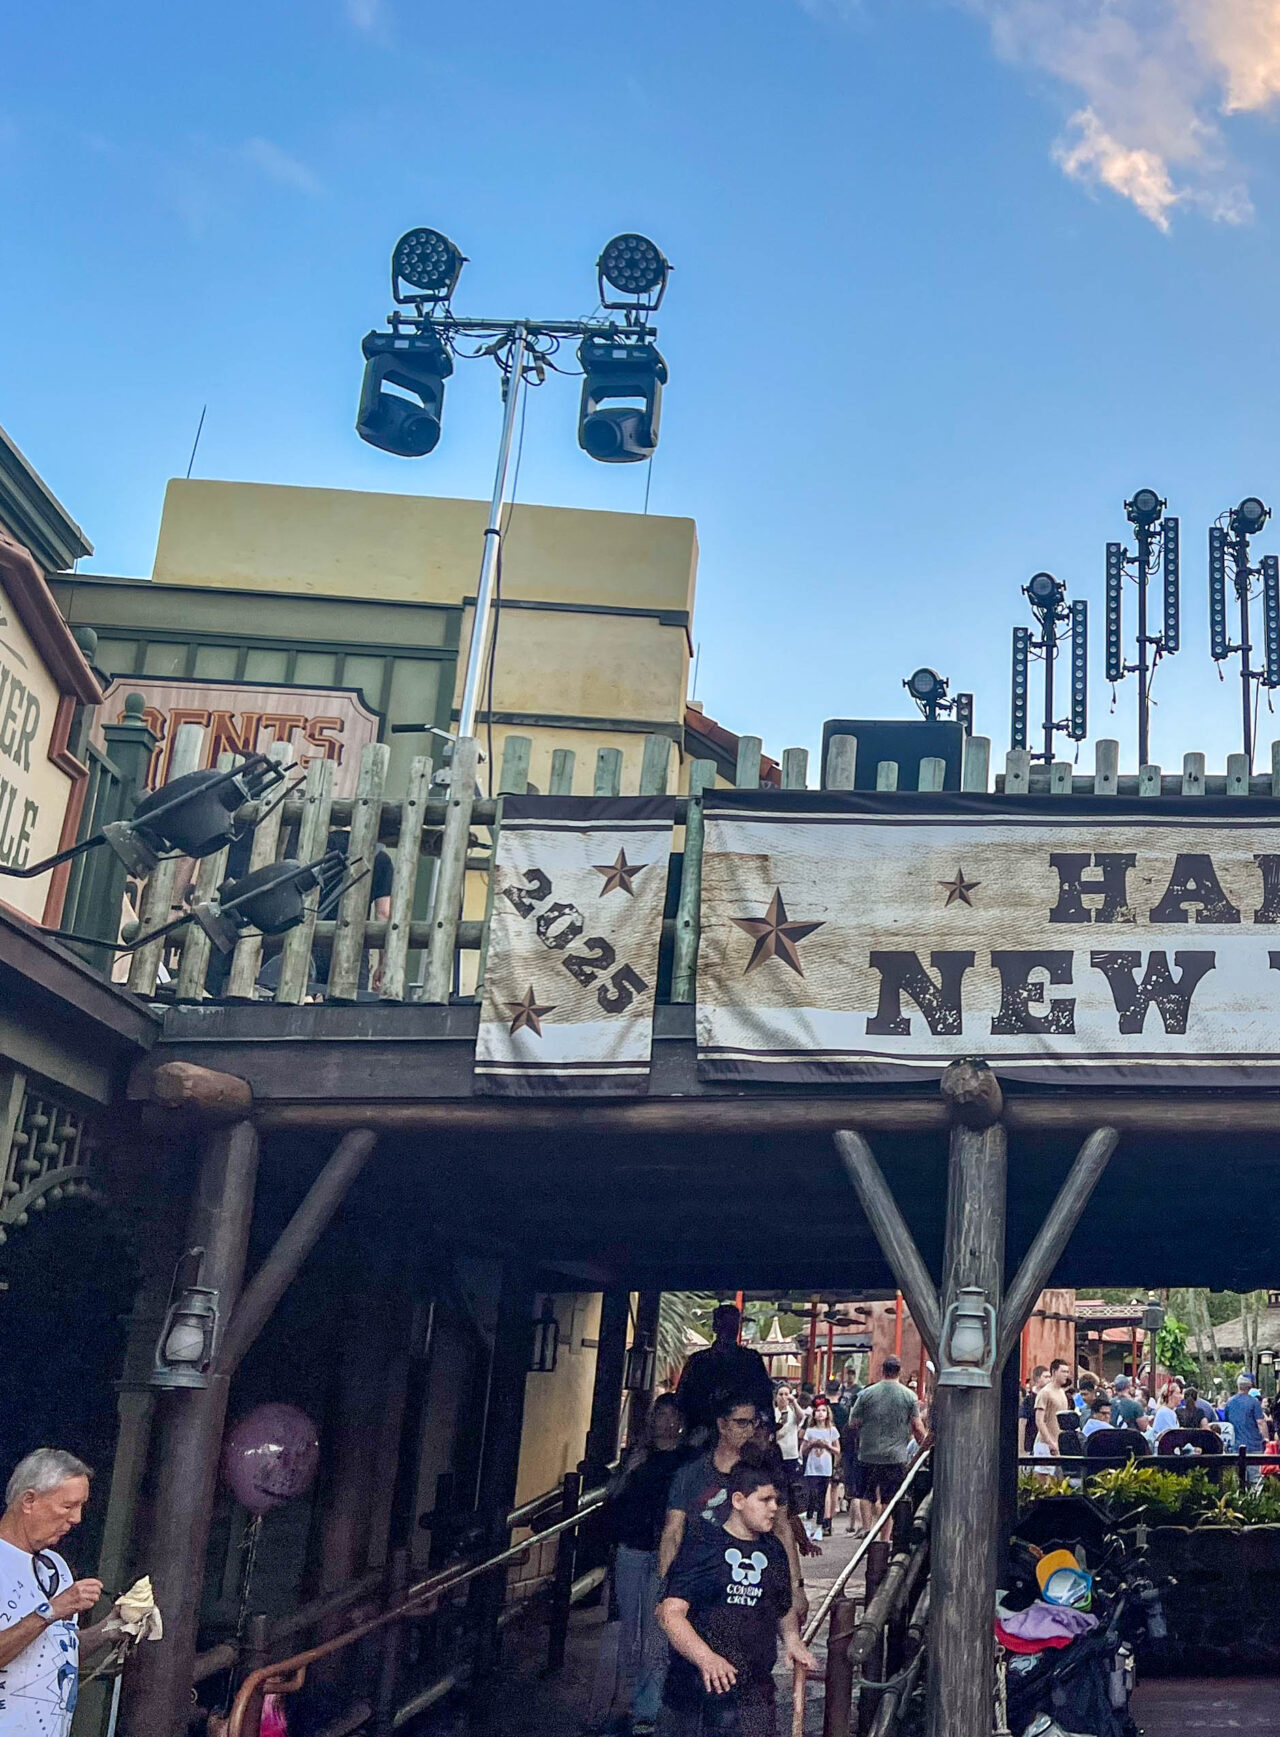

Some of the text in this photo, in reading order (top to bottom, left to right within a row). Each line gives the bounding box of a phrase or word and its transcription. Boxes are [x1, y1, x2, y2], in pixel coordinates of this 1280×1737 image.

[502, 868, 649, 1014] 2025
[865, 950, 1217, 1036] NEW
[727, 1596, 757, 1606] CREW
